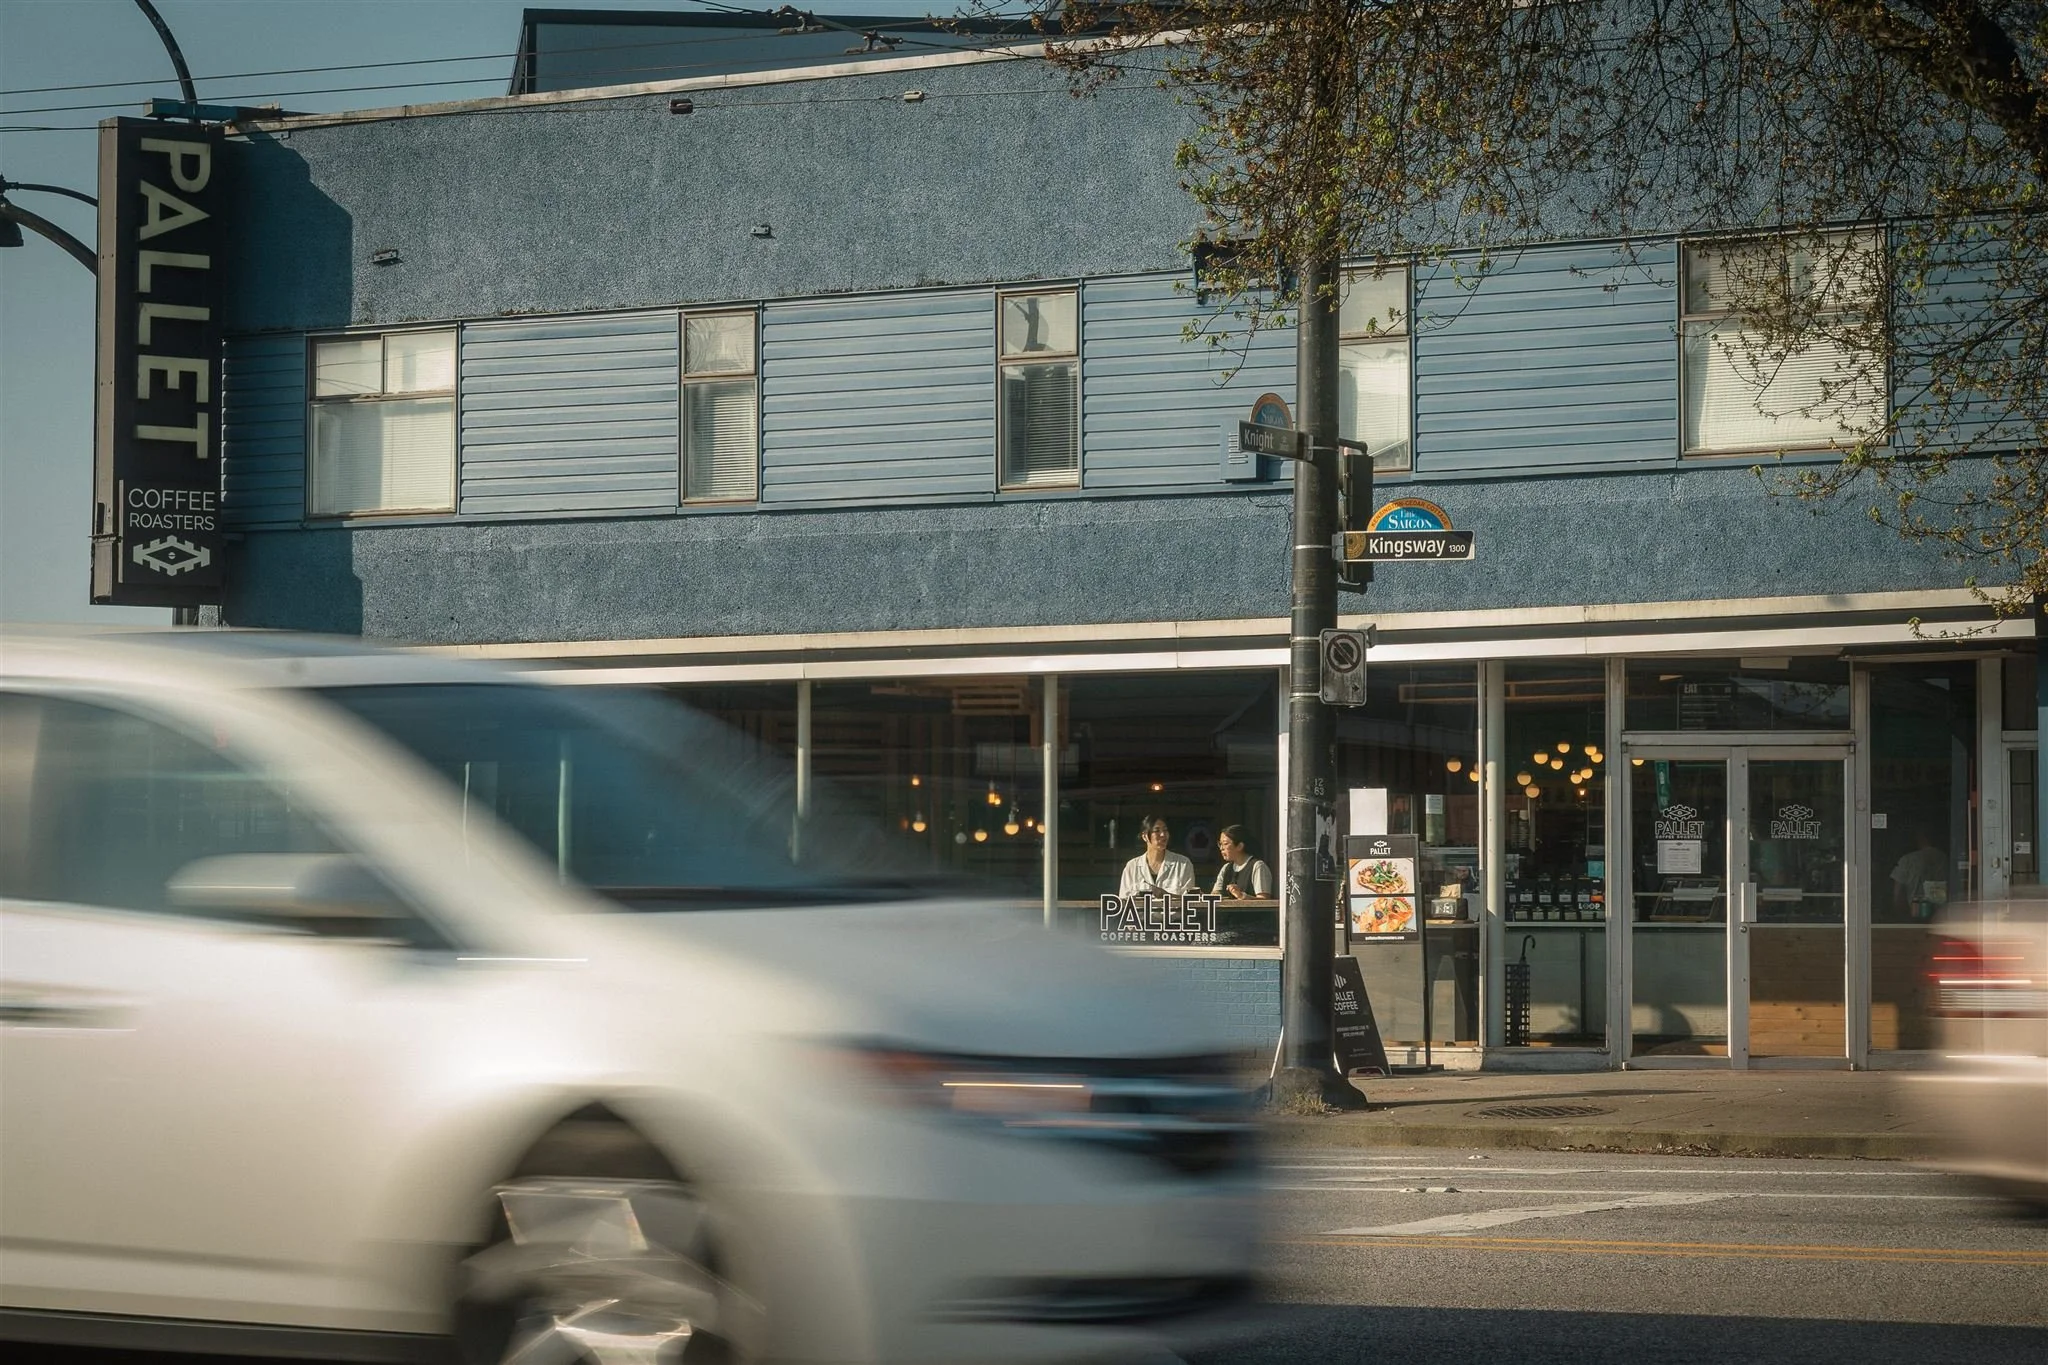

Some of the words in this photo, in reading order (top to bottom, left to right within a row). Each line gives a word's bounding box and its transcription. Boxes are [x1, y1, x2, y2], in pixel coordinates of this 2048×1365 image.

[137, 137, 211, 459] PALLET
[1244, 428, 1274, 452] Knight
[129, 488, 216, 511] COFFEE
[129, 512, 215, 531] ROASTERS
[1369, 537, 1446, 557] Kingsway
[1449, 544, 1466, 553] 1300
[1655, 821, 1704, 835] PALLET
[1771, 821, 1821, 835] PALLET
[1369, 847, 1391, 855] PALLET
[1100, 893, 1222, 932] PALLET
[1100, 932, 1146, 941] COFFEE
[1153, 932, 1217, 942] ROASTERS
[1334, 990, 1355, 1001] ALLET
